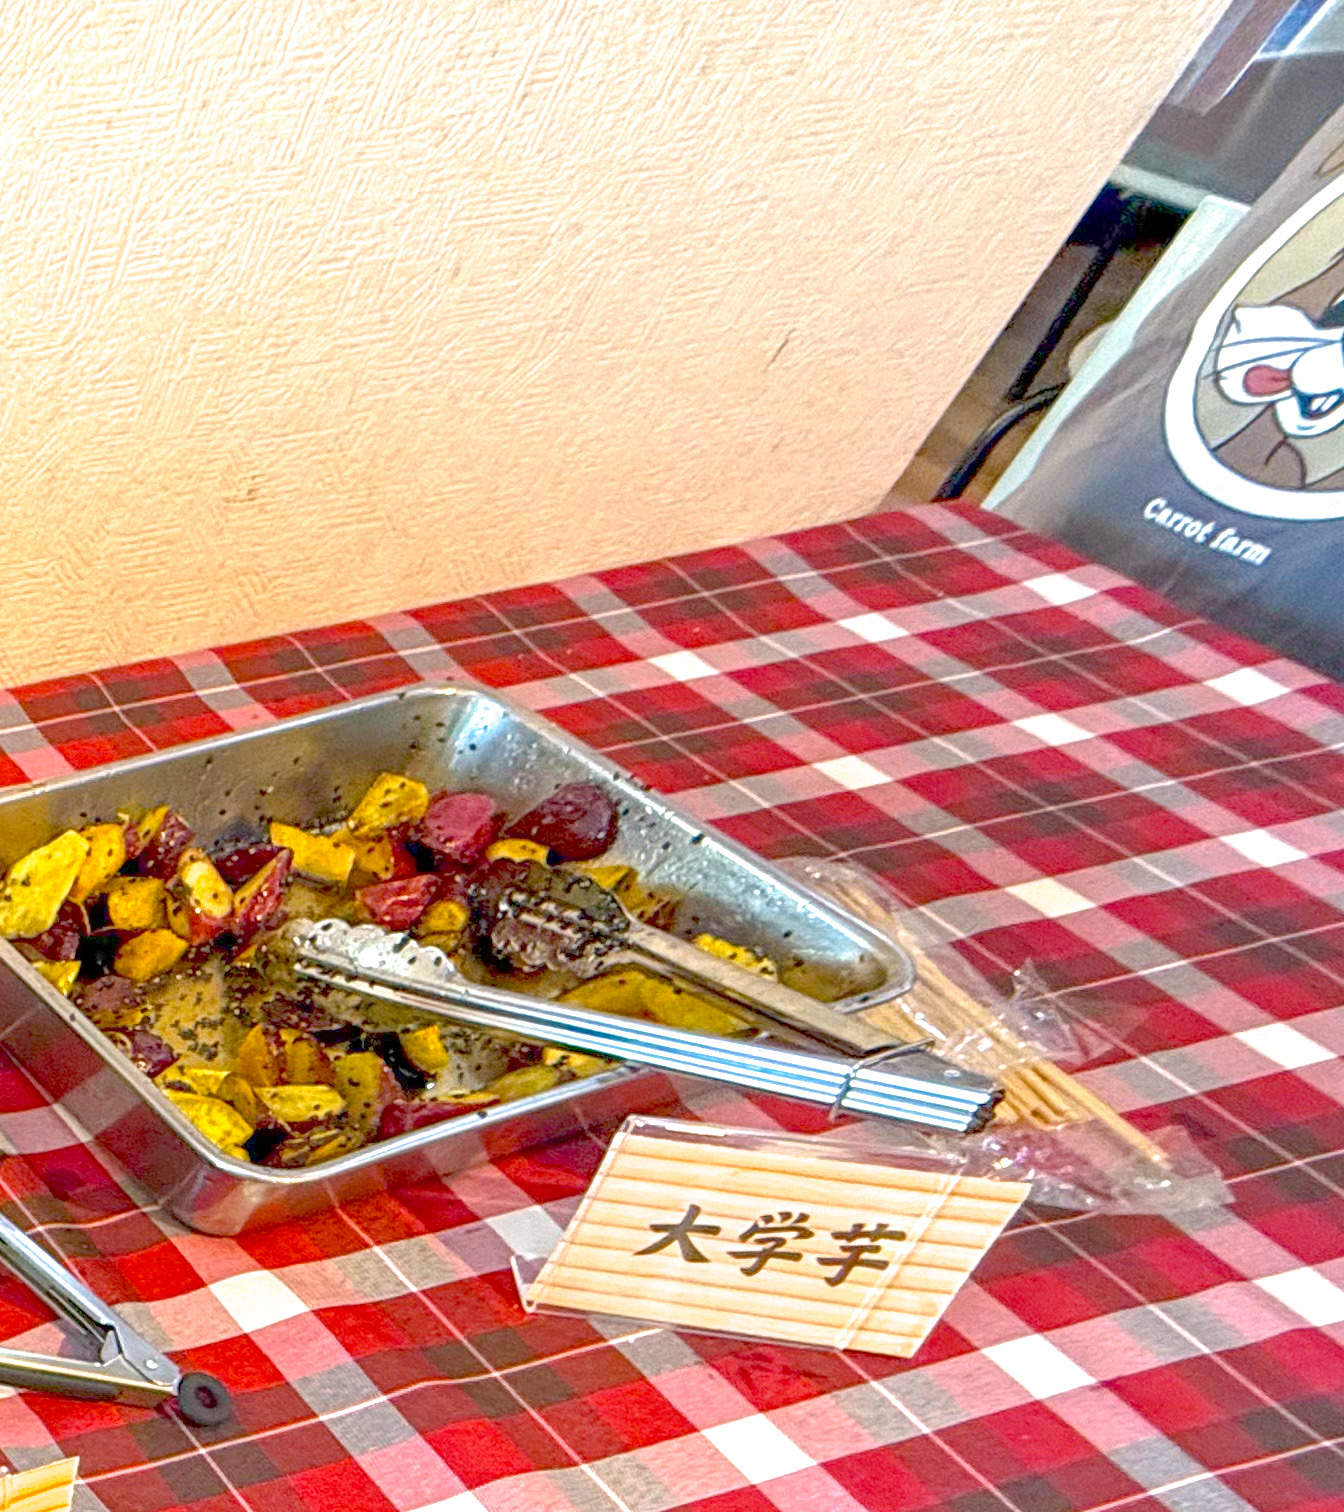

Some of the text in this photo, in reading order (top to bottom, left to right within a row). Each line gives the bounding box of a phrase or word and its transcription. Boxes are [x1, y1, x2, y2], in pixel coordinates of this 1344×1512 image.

[1143, 497, 1273, 566] Carrot farm
[633, 1203, 908, 1287] 大学芋
